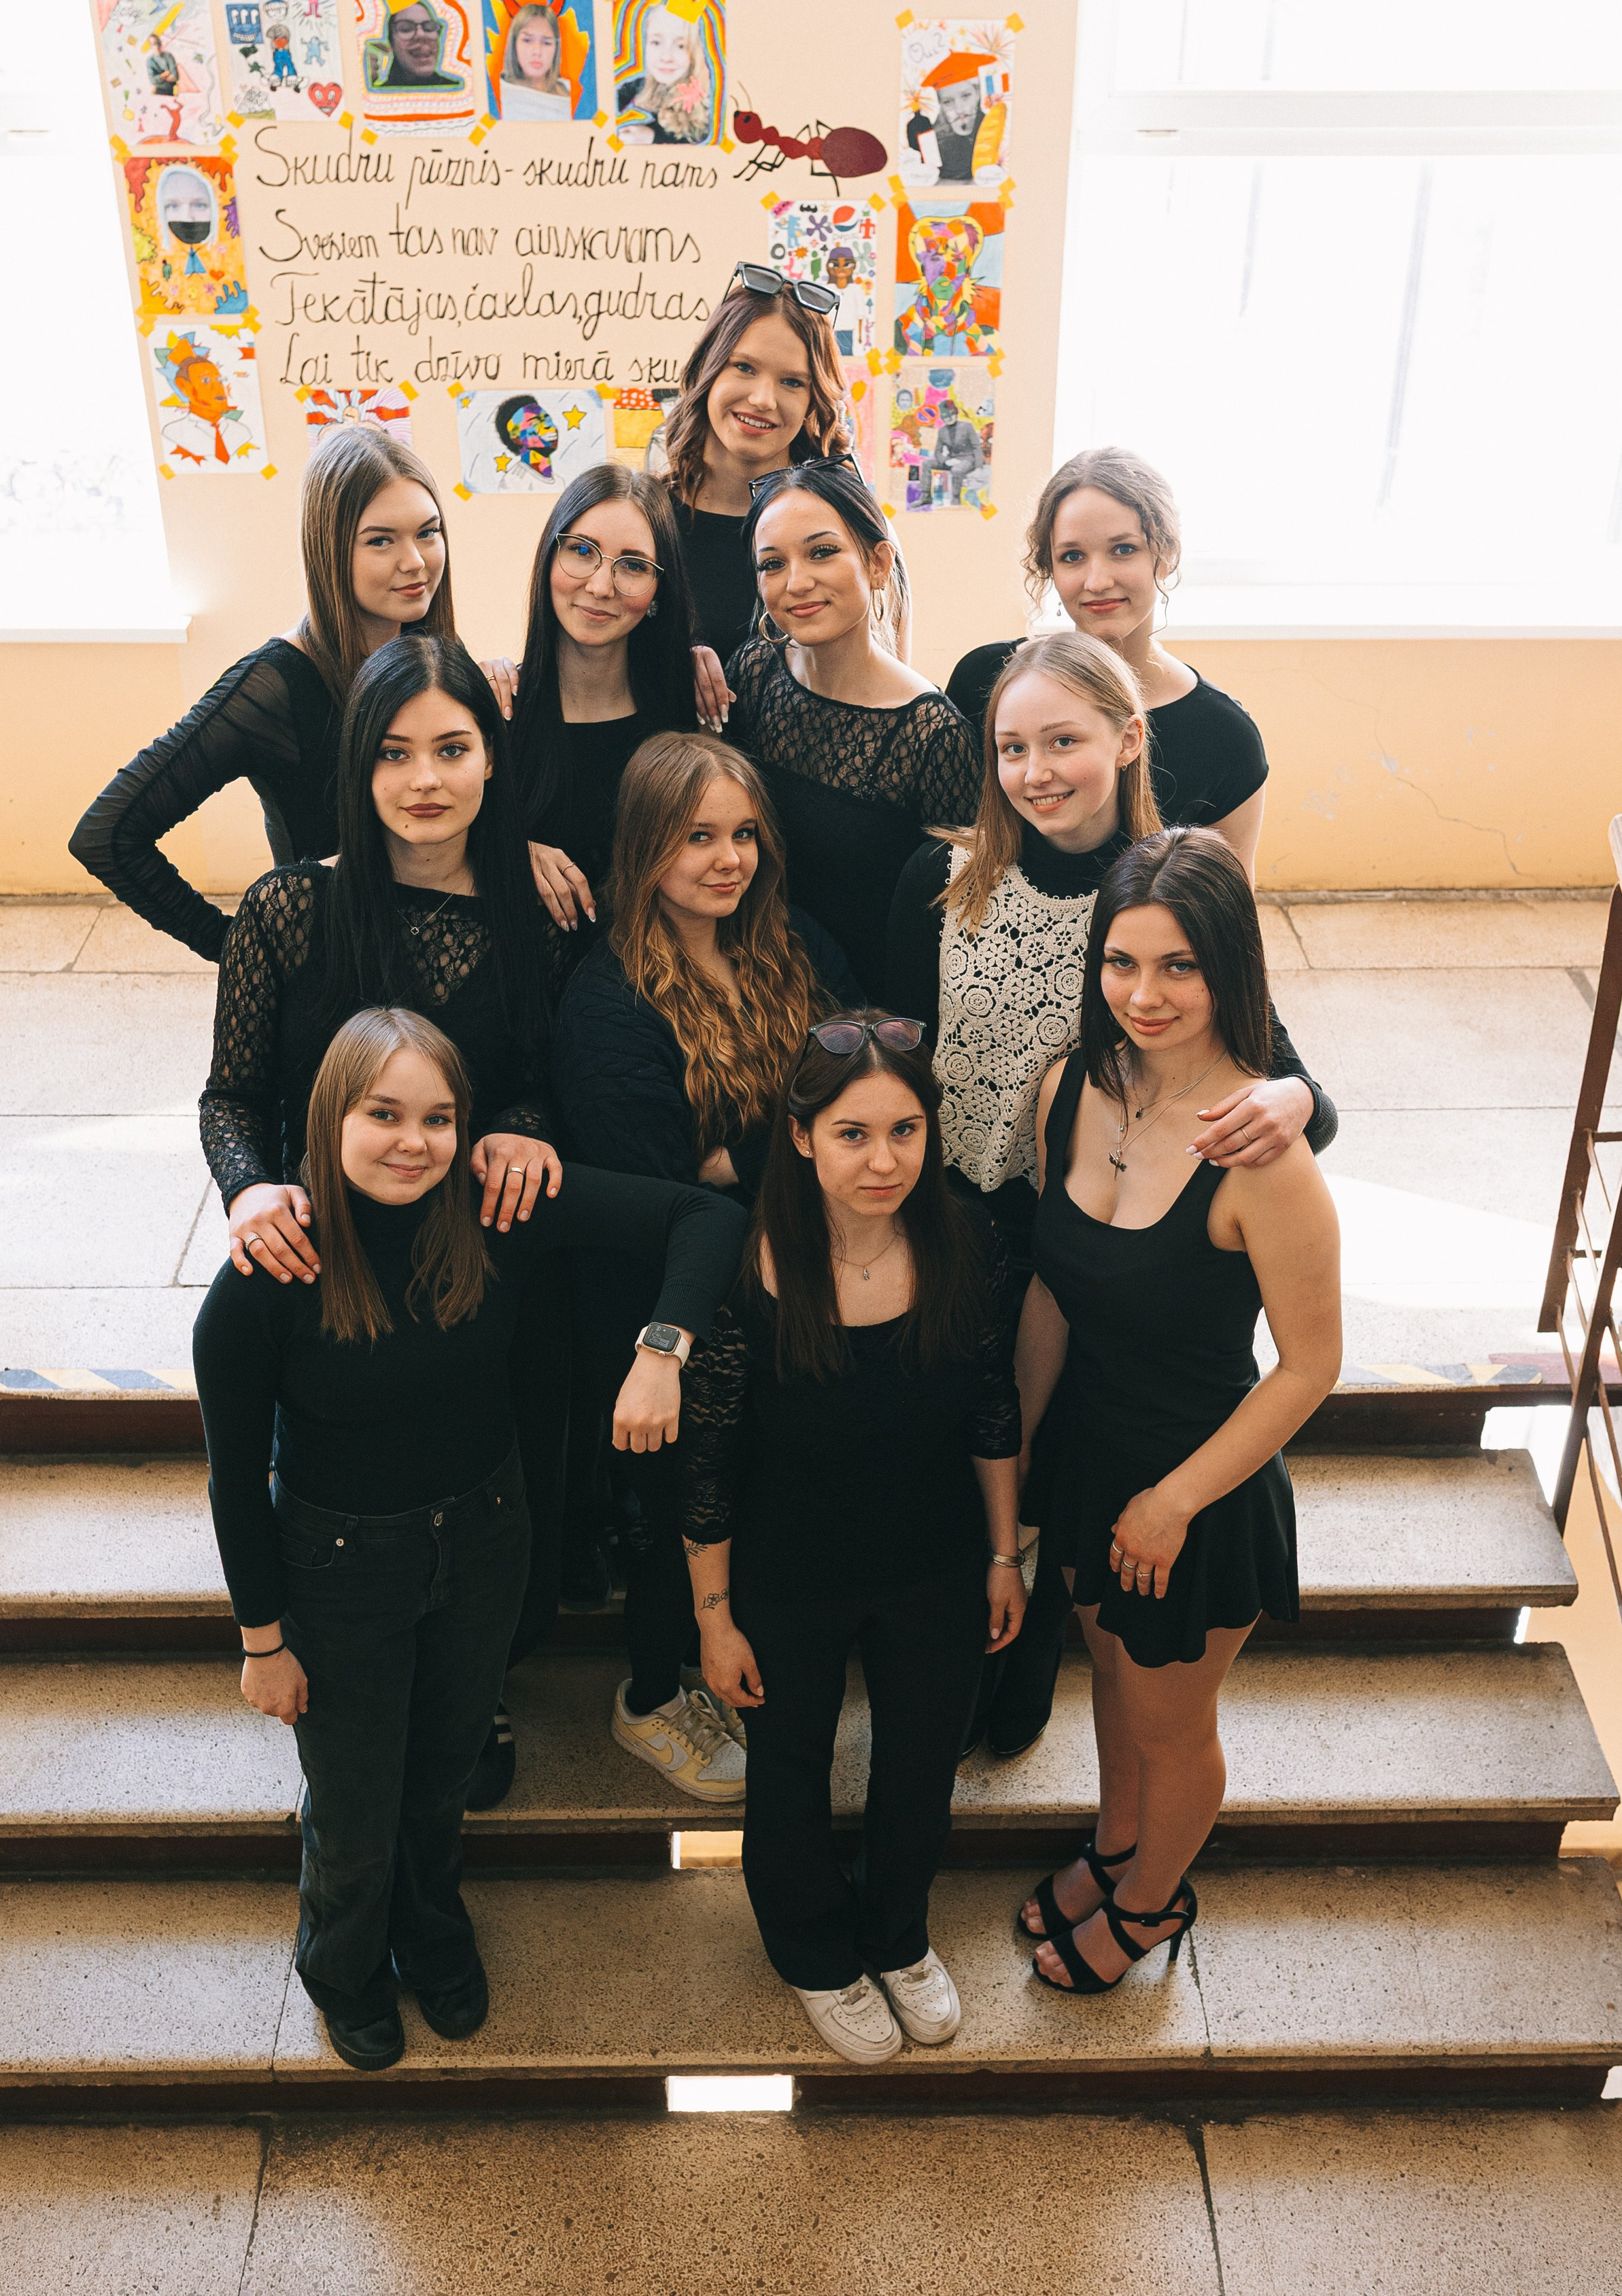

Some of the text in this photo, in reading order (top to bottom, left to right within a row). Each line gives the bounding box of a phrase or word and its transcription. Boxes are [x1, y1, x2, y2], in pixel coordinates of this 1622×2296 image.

[255, 121, 395, 187] Skudru
[523, 136, 629, 188] skudru
[640, 159, 717, 188] nams
[389, 202, 443, 258] tas
[452, 225, 498, 257] nav
[280, 332, 680, 385] Lai tik dzīvo mierā sku
